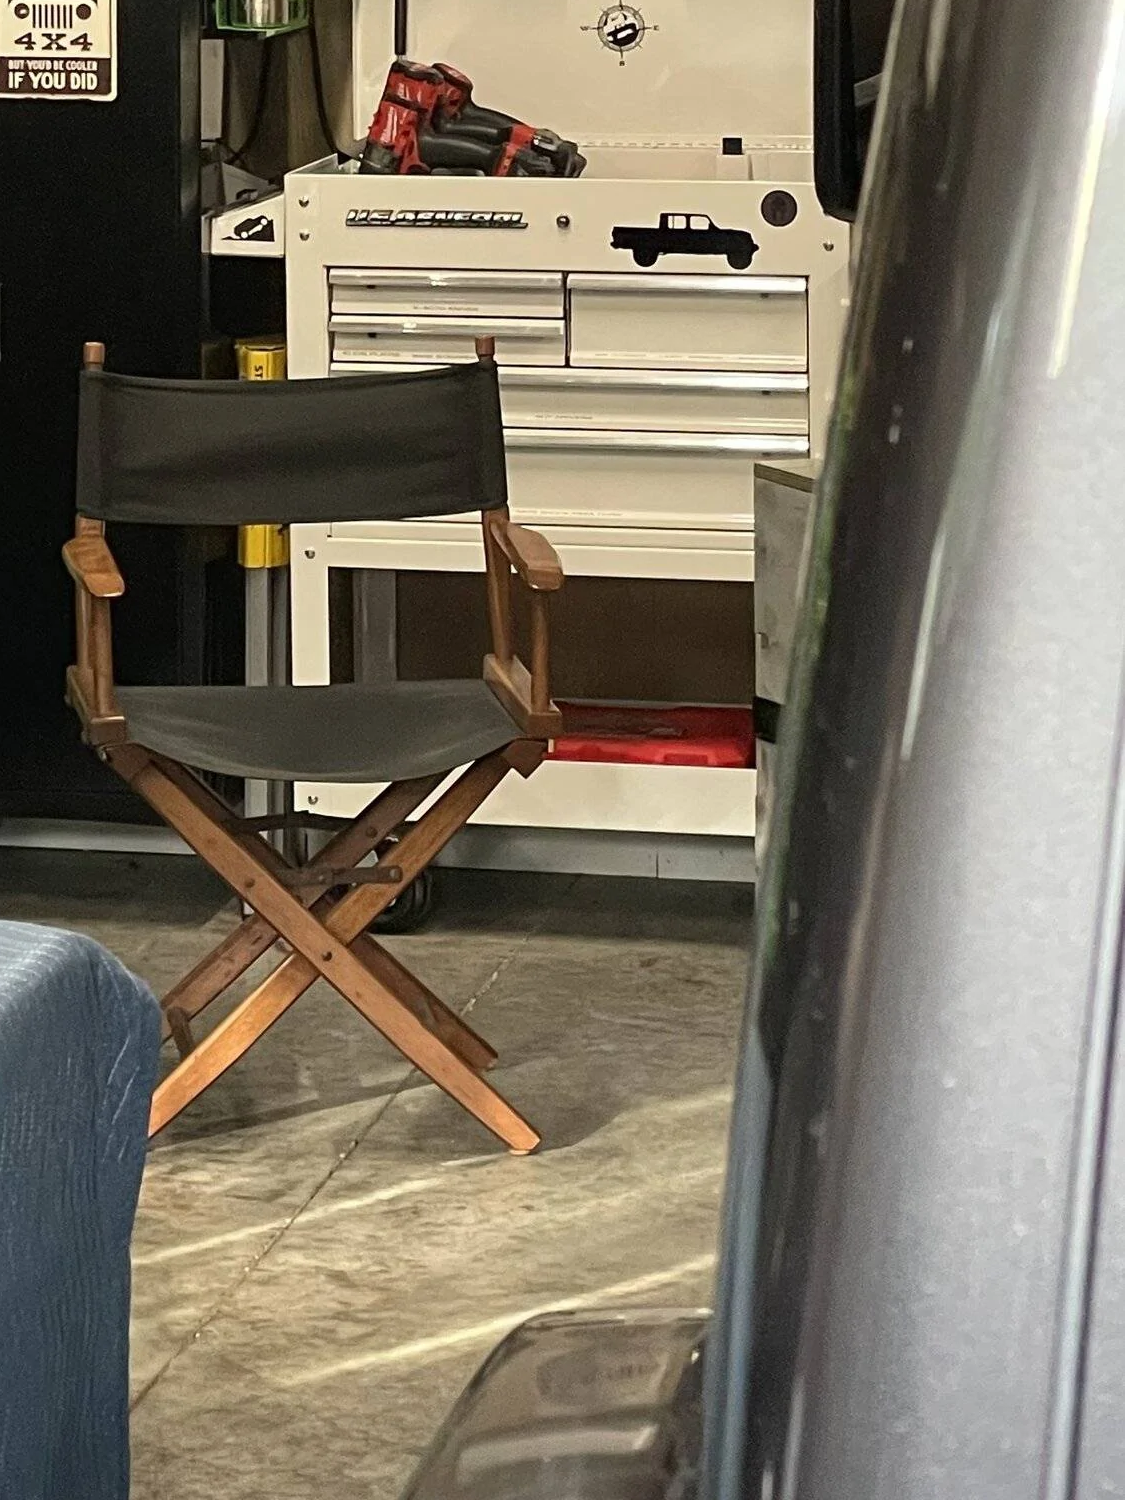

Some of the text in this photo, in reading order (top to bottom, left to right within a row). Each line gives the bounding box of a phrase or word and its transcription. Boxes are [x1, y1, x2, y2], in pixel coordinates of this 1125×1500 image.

[8, 59, 98, 71] BUT YOU'D BE COOLER
[8, 72, 98, 91] IF YOU DID
